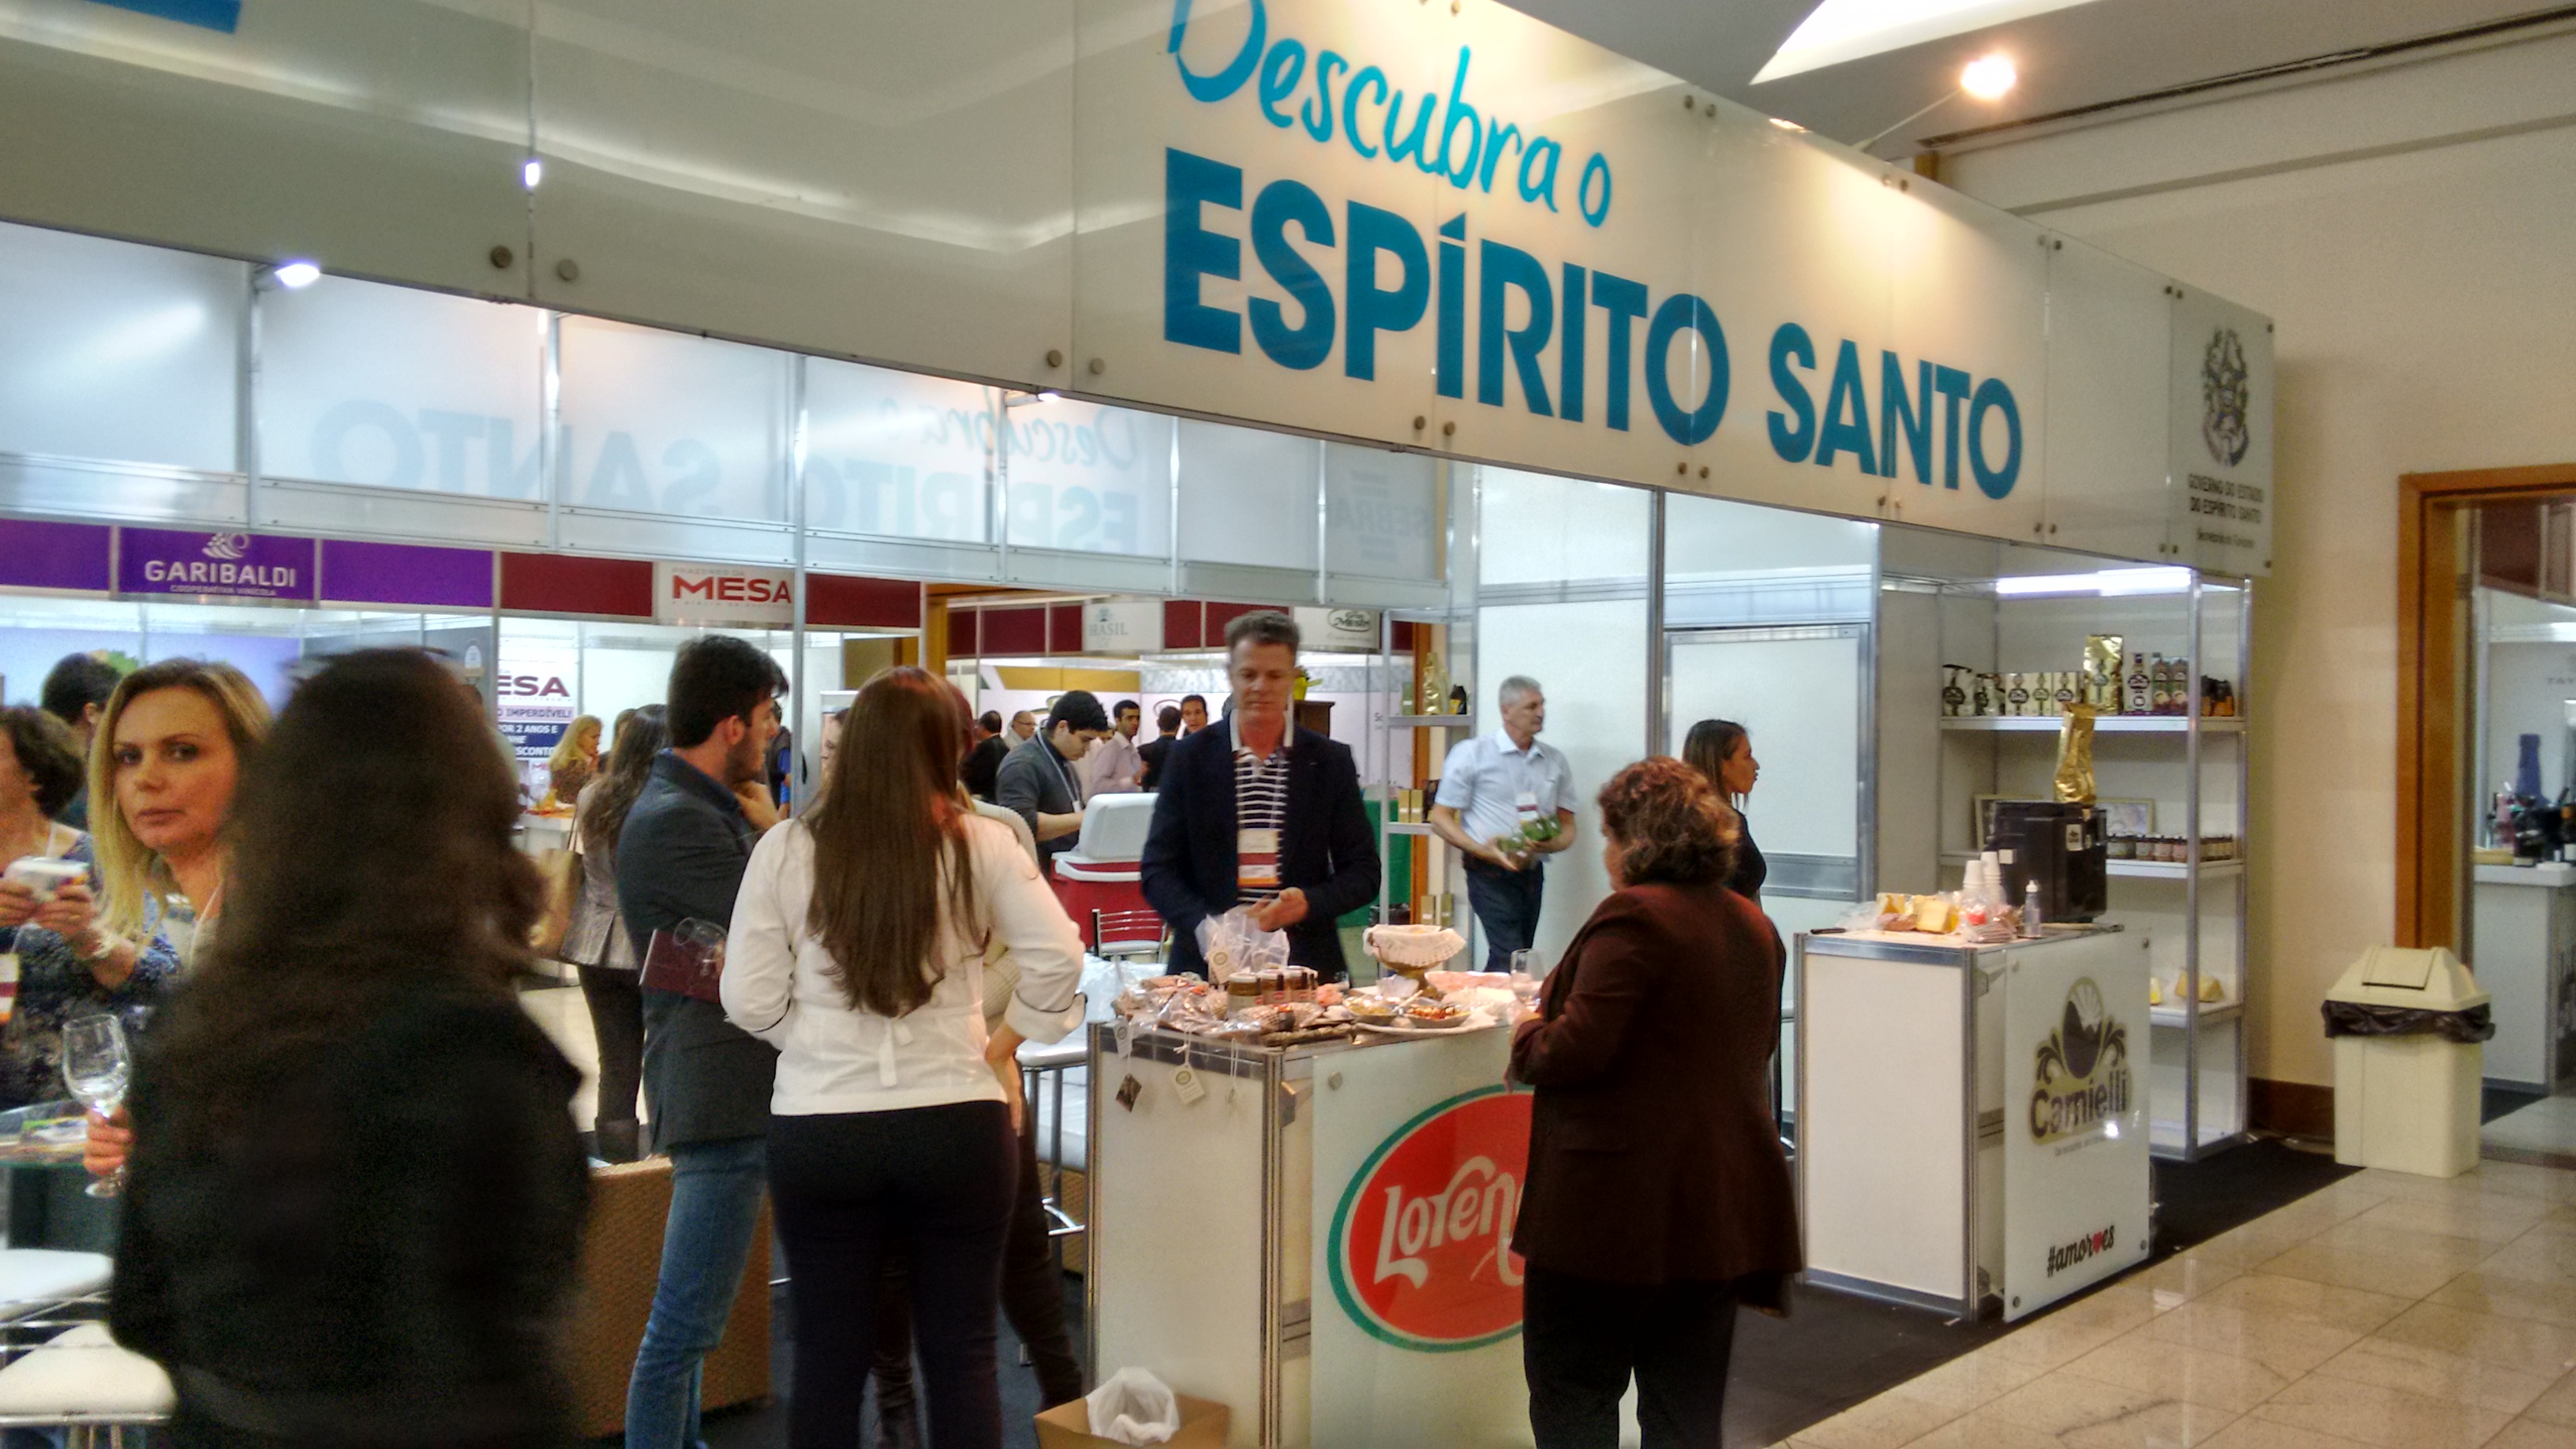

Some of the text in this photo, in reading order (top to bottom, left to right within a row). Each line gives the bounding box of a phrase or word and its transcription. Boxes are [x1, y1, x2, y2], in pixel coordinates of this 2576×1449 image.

[1167, 0, 1612, 228] Descubra o
[1164, 146, 2023, 500] ESPÍRITO SANTO
[144, 560, 297, 588] GARIBALDI
[672, 575, 791, 604] MESA
[498, 675, 570, 698] ESA
[524, 724, 550, 733] ANOS
[551, 724, 558, 734] E
[1373, 1155, 1525, 1290] Loren
